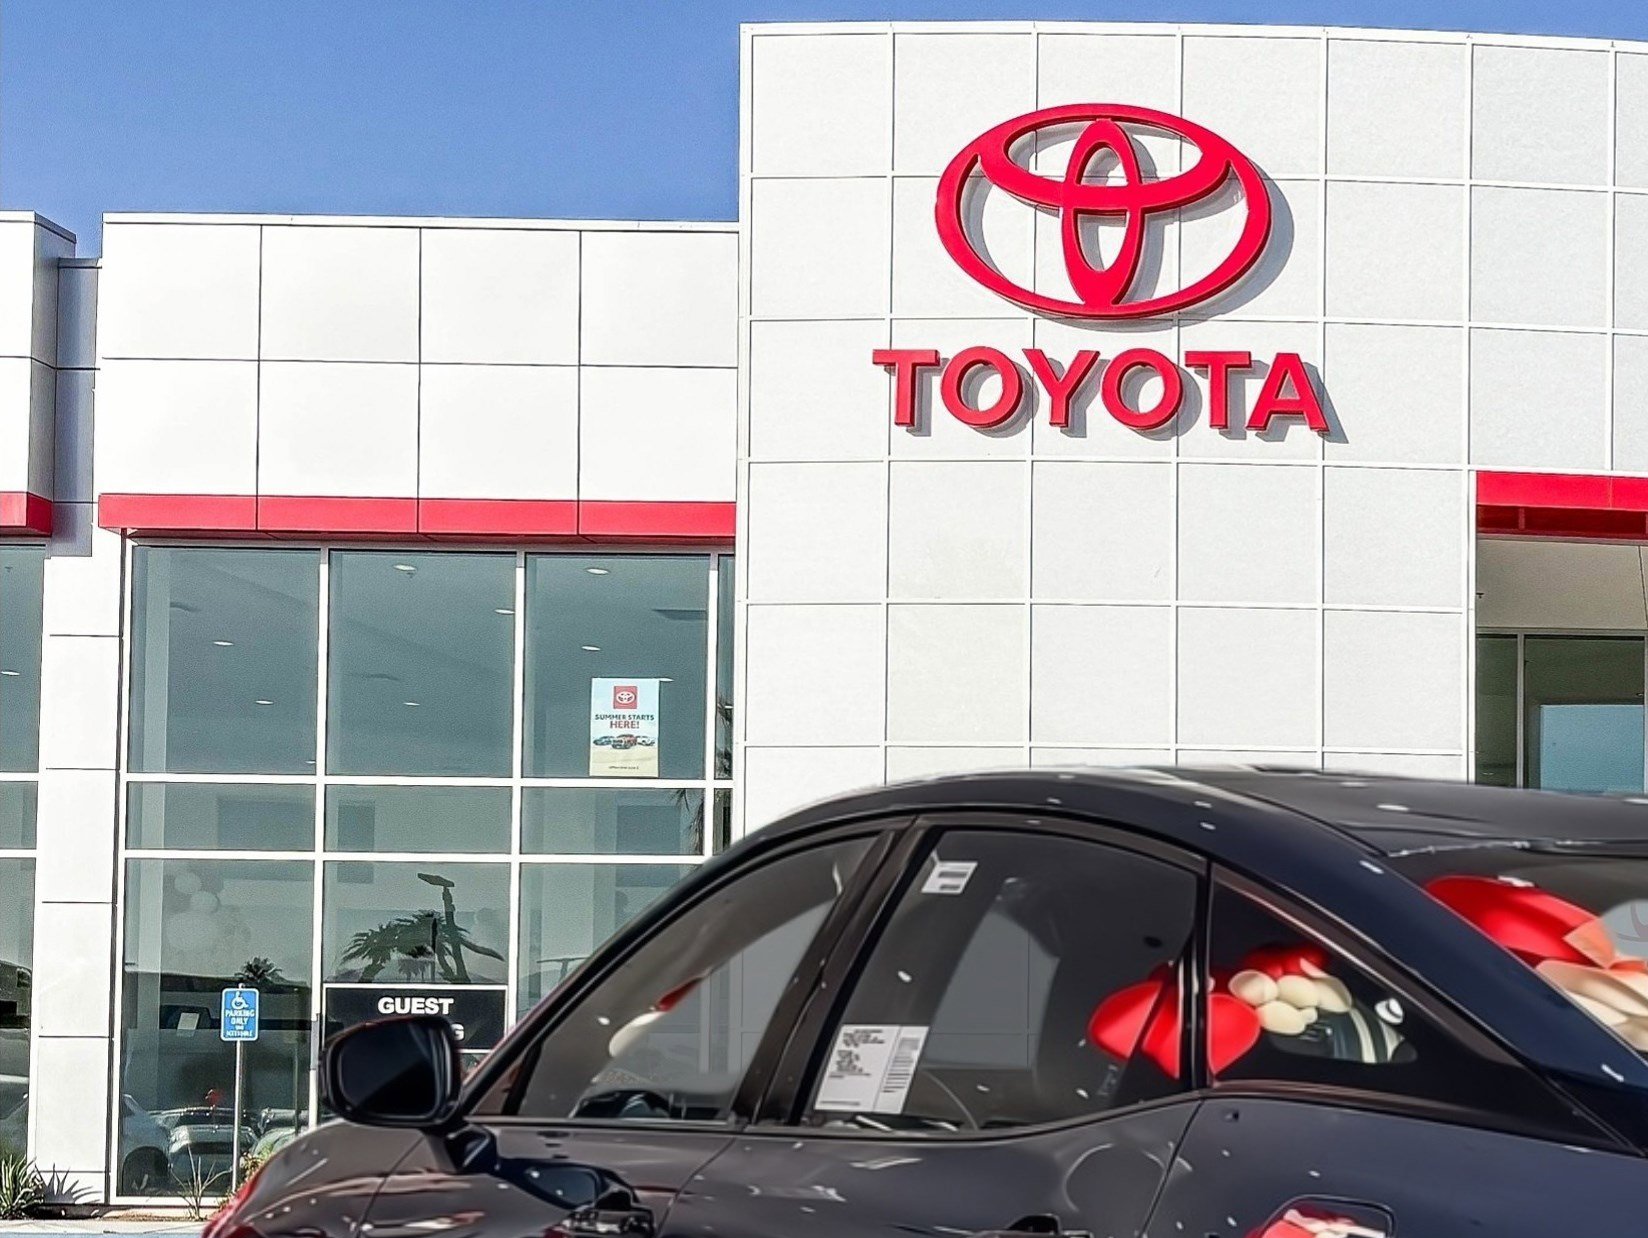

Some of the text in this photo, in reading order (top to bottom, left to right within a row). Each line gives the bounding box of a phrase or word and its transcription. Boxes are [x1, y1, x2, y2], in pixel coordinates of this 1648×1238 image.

[872, 346, 1330, 432] TOYOTA
[609, 721, 640, 729] HERE!
[377, 997, 454, 1015] GUEST
